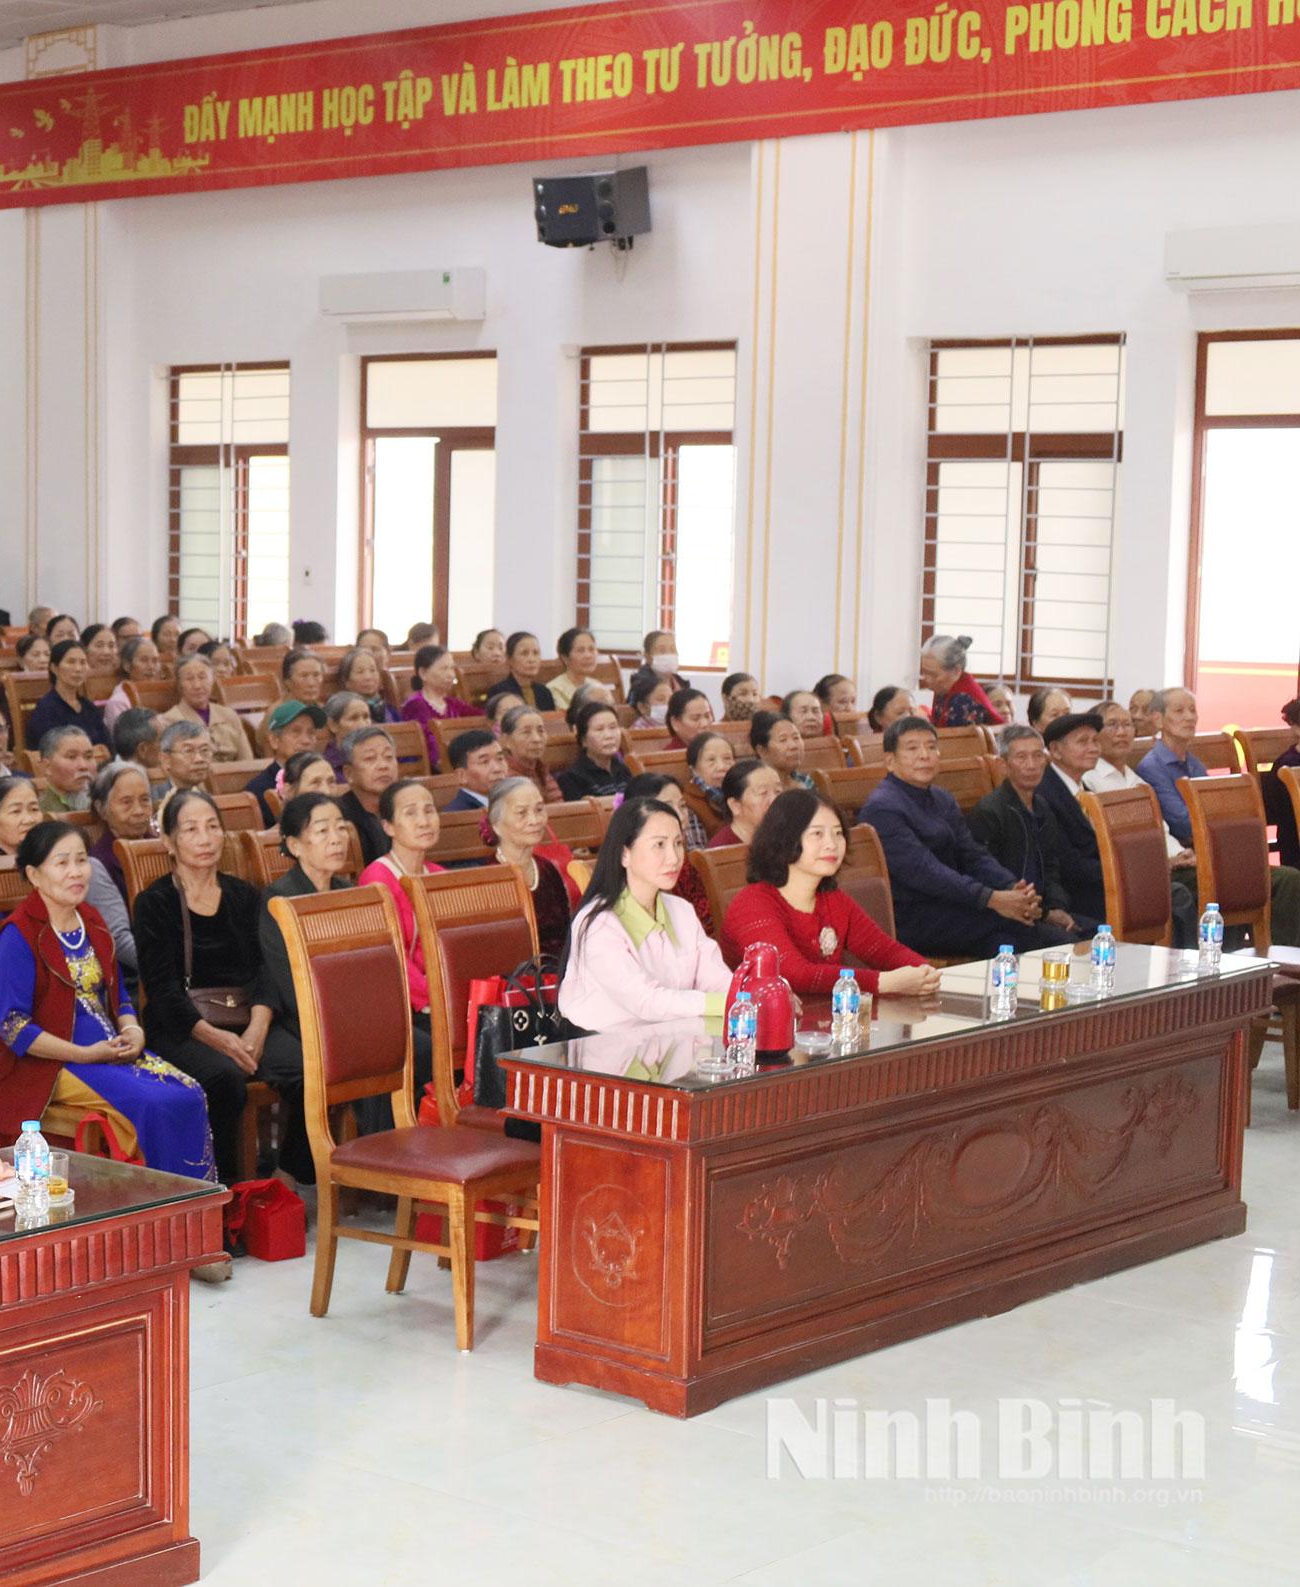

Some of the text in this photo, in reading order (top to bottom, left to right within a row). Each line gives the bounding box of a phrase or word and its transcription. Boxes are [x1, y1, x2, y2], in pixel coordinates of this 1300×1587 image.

[183, 92, 232, 145] ĐẨY
[237, 89, 315, 145] MẠNH
[321, 83, 376, 138] HỌC
[381, 68, 434, 129] TẬP
[440, 62, 479, 117] VÀ
[485, 55, 552, 113] LÀM
[557, 50, 635, 106] THEO
[641, 42, 685, 96] TƯ
[693, 20, 813, 89] TƯỞNG,
[822, 18, 895, 82] ĐẠO
[903, 1, 993, 67] ĐỨC,
[1003, 0, 1134, 57] PHONG
